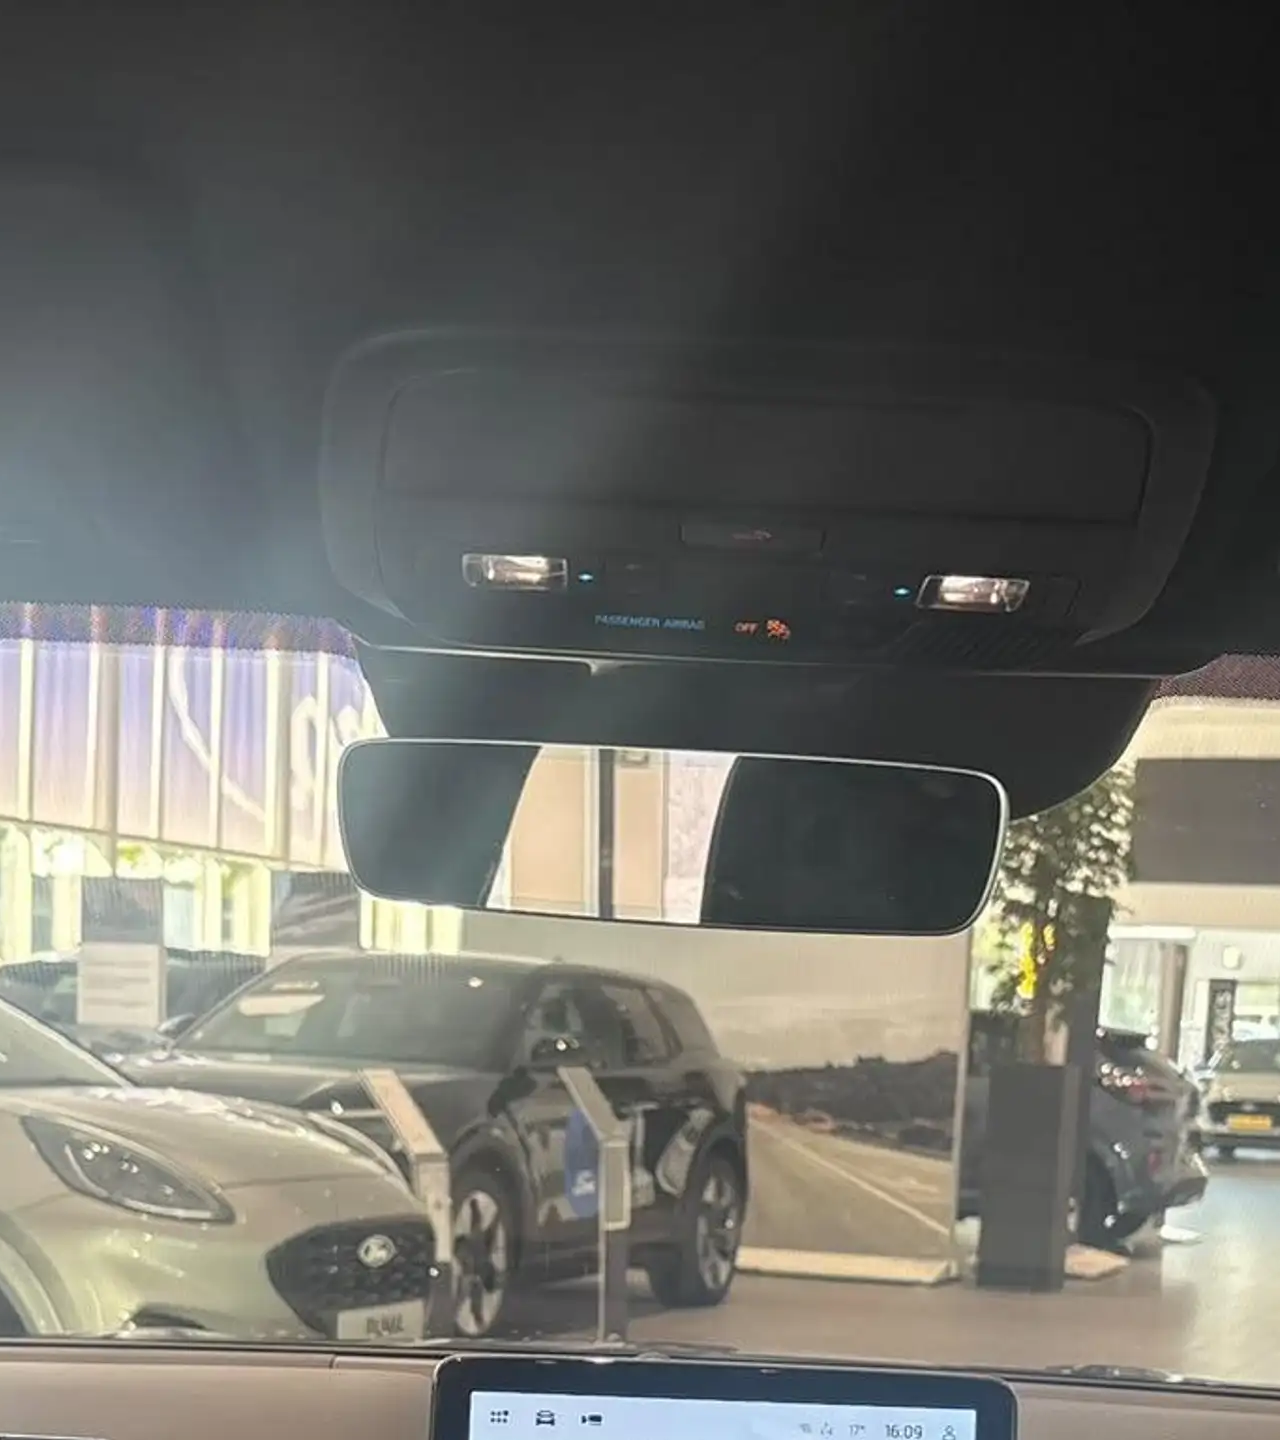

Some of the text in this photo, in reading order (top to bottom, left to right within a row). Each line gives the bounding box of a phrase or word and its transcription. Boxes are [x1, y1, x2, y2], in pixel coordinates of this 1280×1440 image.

[594, 615, 705, 631] PASSENGER AIRBAG
[734, 621, 759, 633] OFF
[885, 1423, 923, 1440] 16:09
